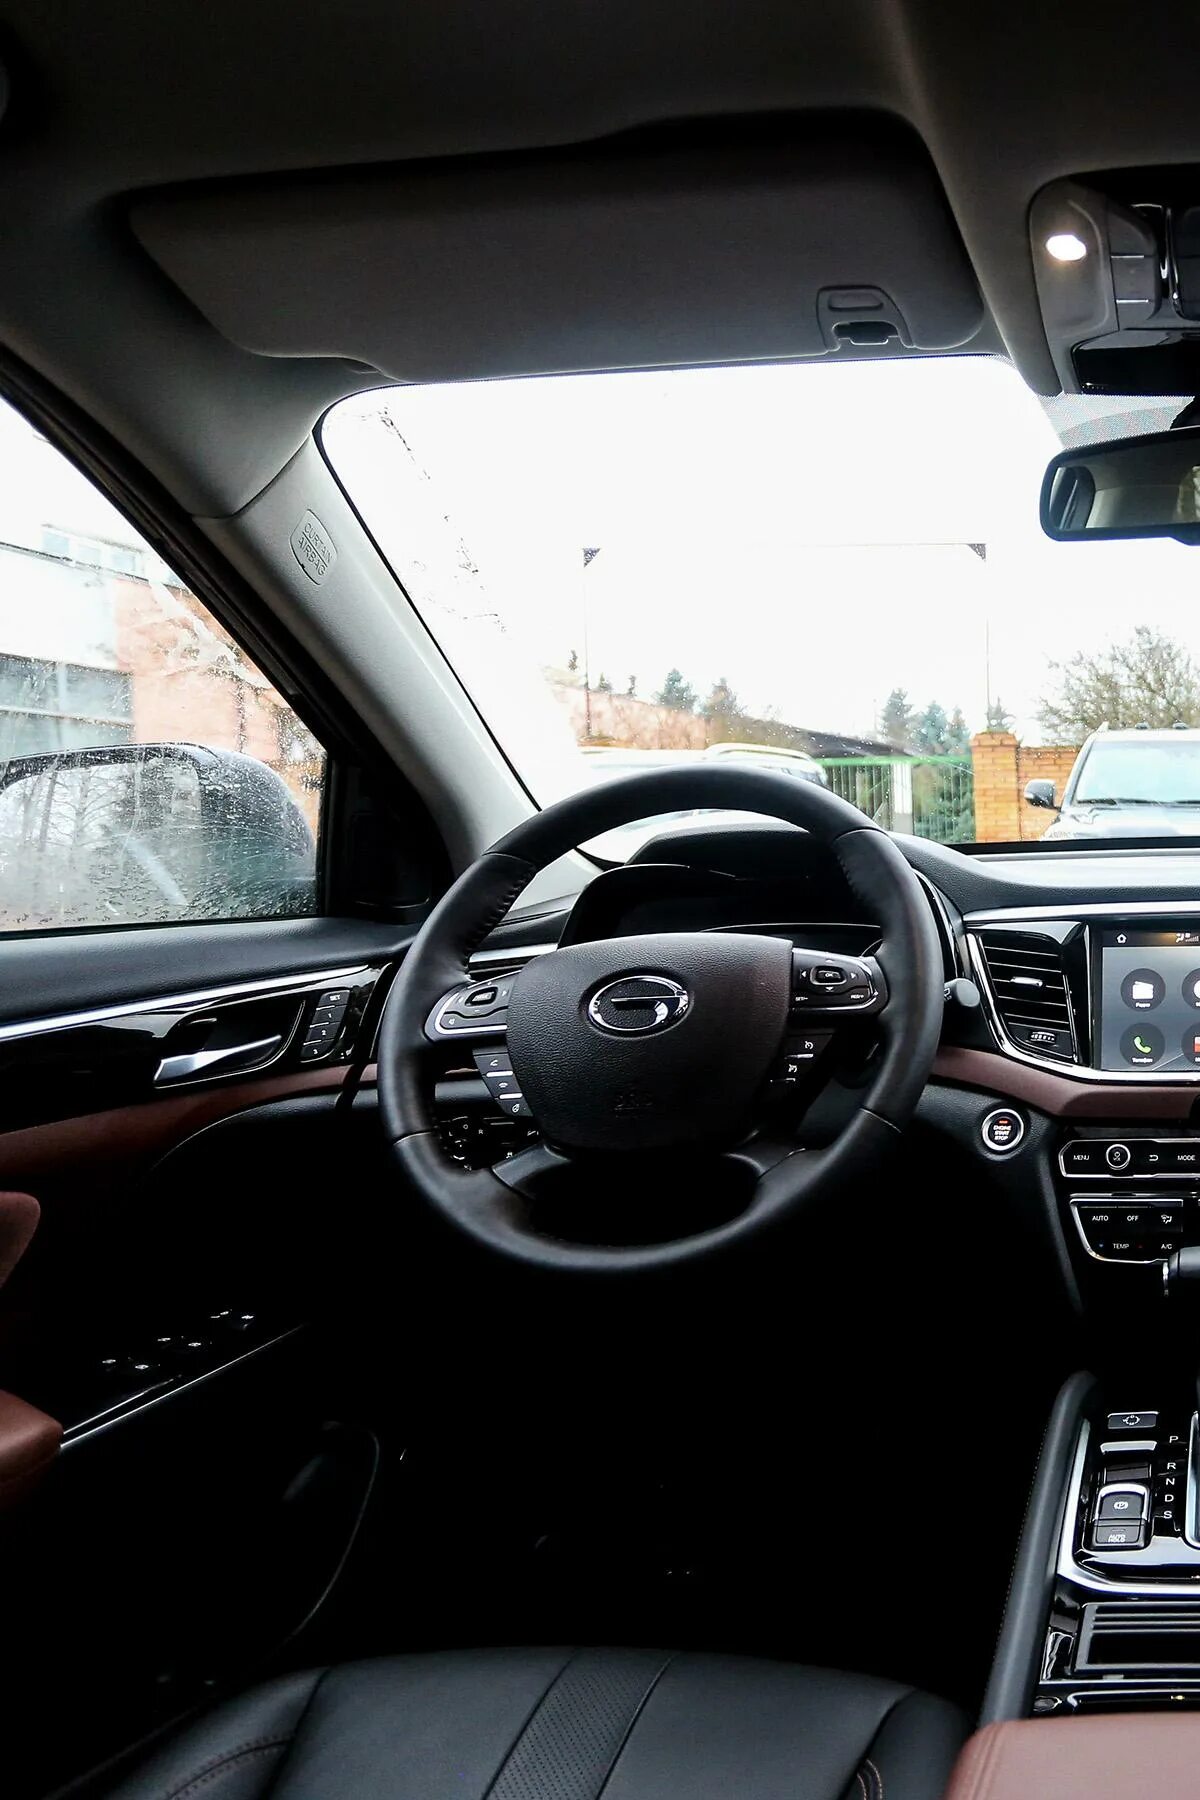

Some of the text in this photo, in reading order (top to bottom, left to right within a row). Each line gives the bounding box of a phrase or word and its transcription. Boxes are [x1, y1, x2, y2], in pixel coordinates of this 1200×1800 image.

[304, 522, 332, 563] CURTAIN
[298, 536, 326, 576] AIRBAG
[1169, 1435, 1179, 1443] P
[1167, 1462, 1176, 1470] R
[1165, 1478, 1175, 1486] N
[1164, 1494, 1174, 1502] D
[1163, 1511, 1173, 1519] S
